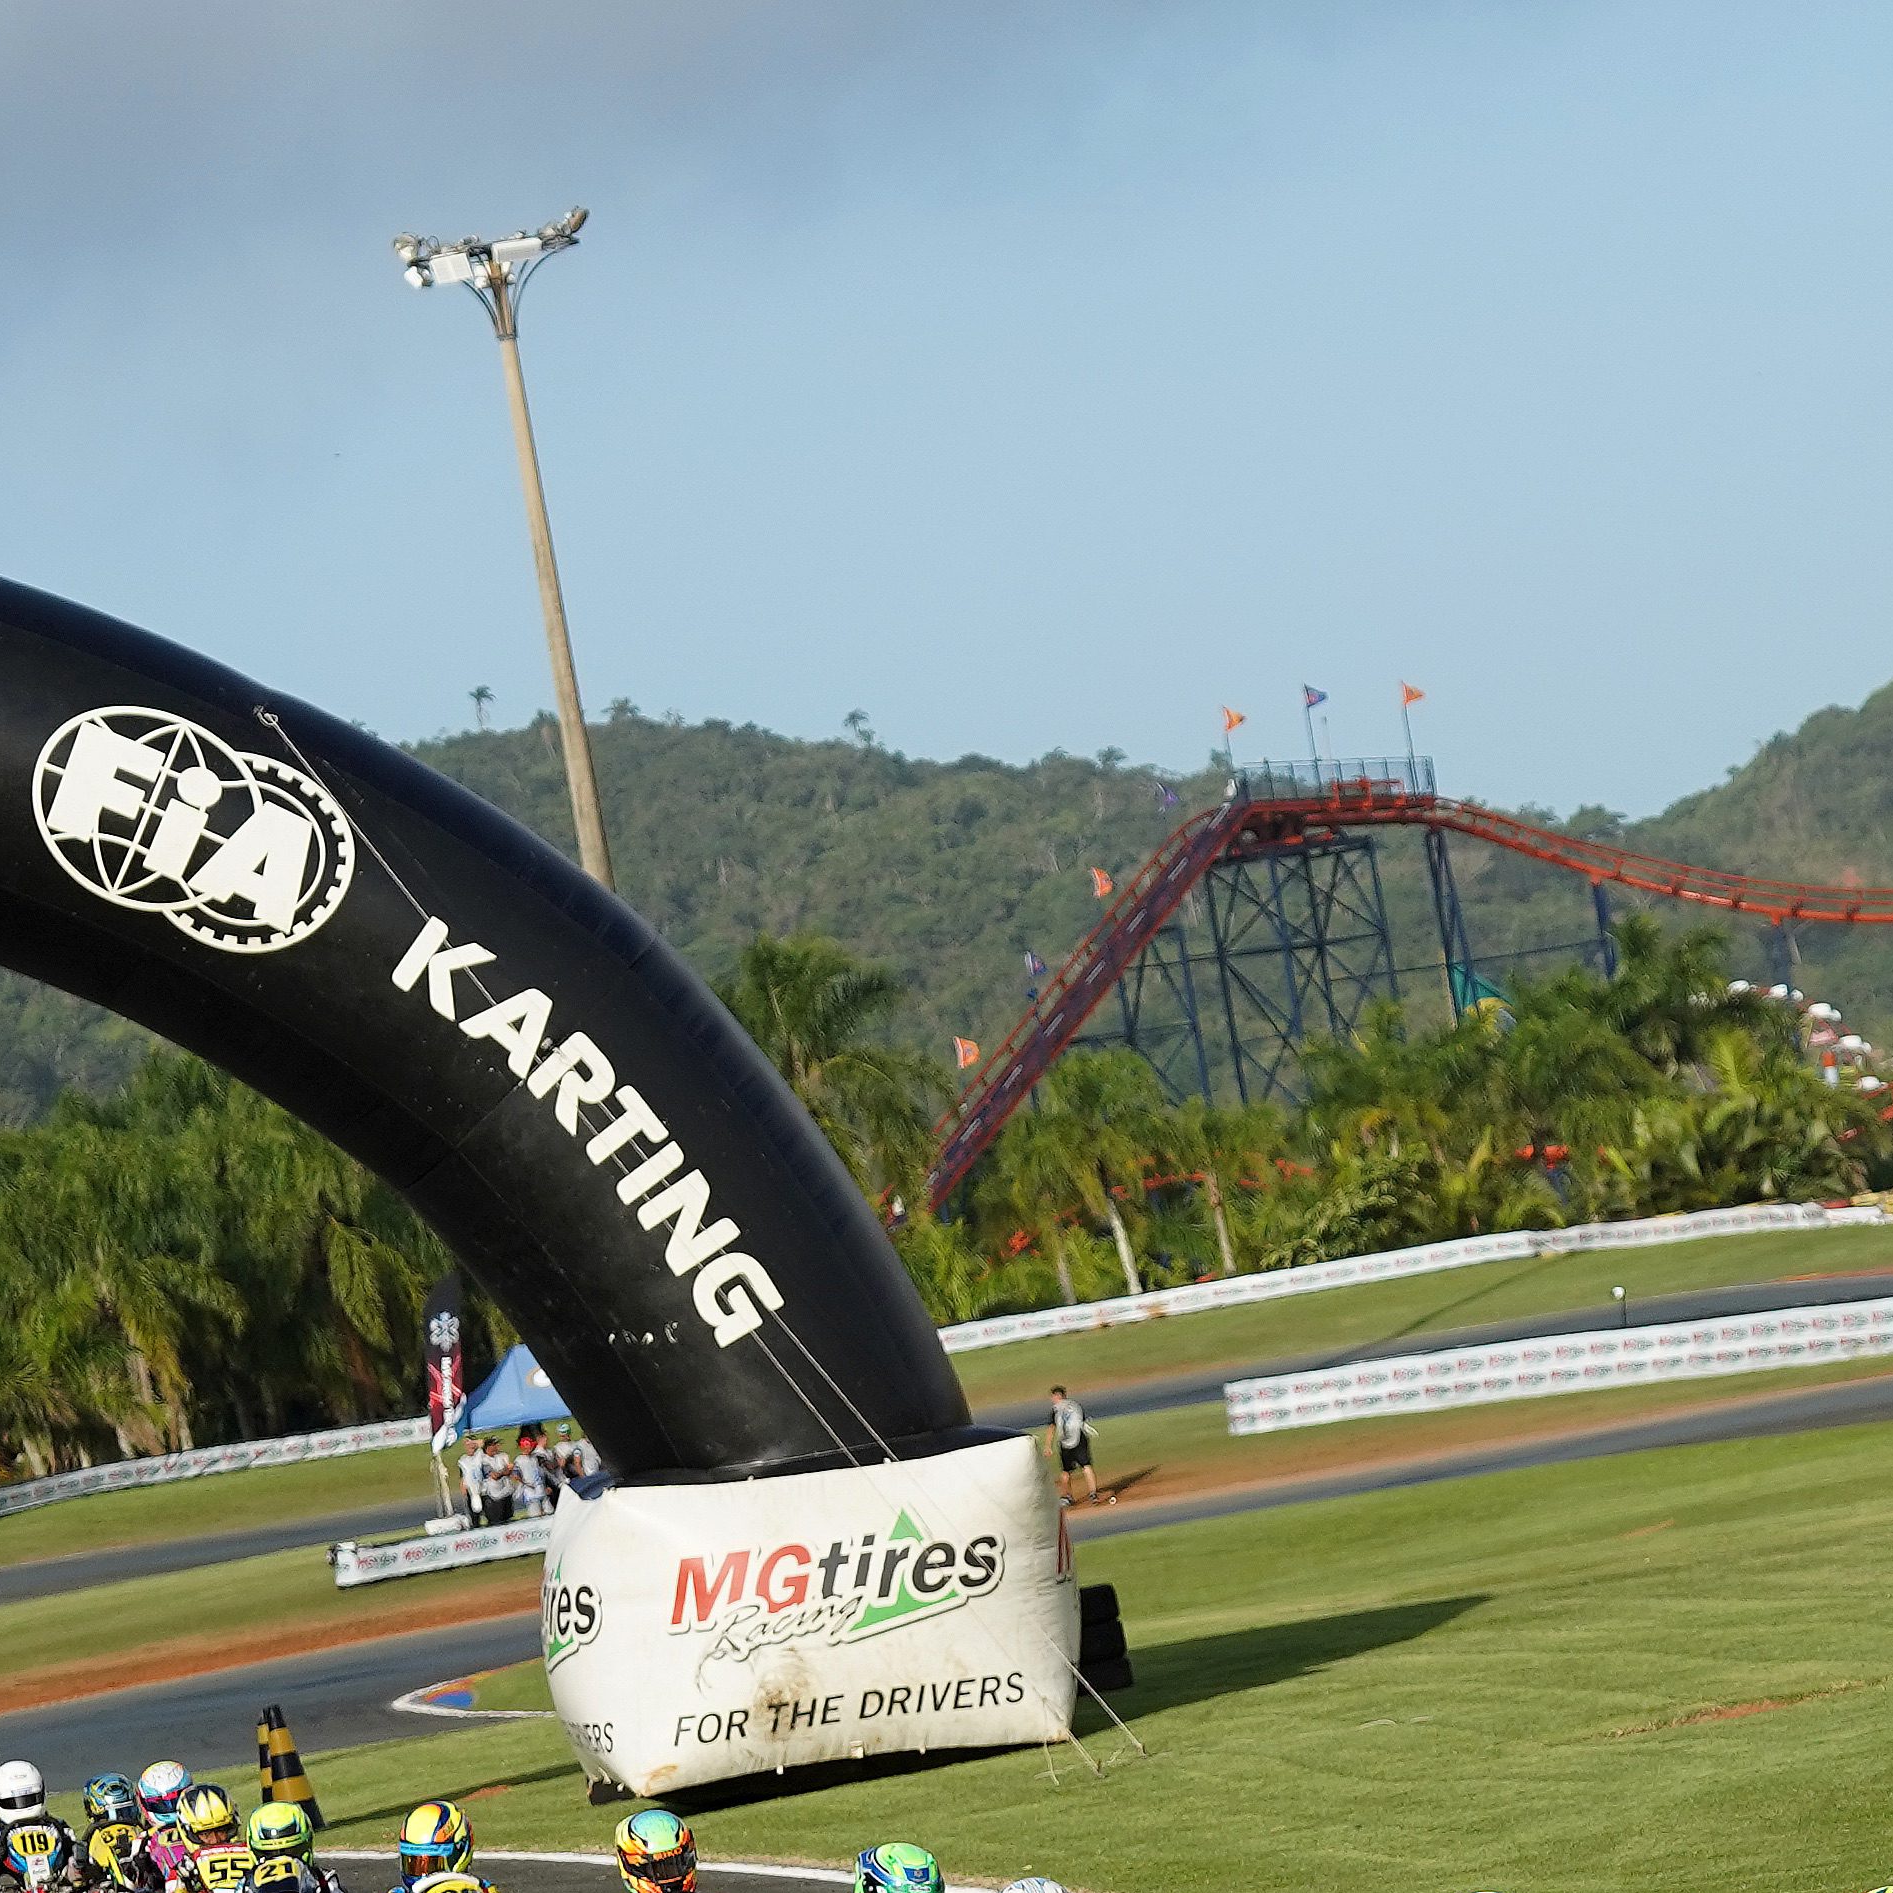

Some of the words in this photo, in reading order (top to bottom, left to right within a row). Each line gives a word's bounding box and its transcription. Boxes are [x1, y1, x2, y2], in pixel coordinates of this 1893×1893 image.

[391, 916, 785, 1349] KARTING
[670, 1533, 1004, 1625] MGtires
[717, 1594, 862, 1661] Racing
[674, 1709, 749, 1747] FOR
[767, 1694, 845, 1734] THE
[859, 1671, 1025, 1721] DRIVERS
[20, 1831, 49, 1853] 119
[209, 1858, 250, 1884] 55
